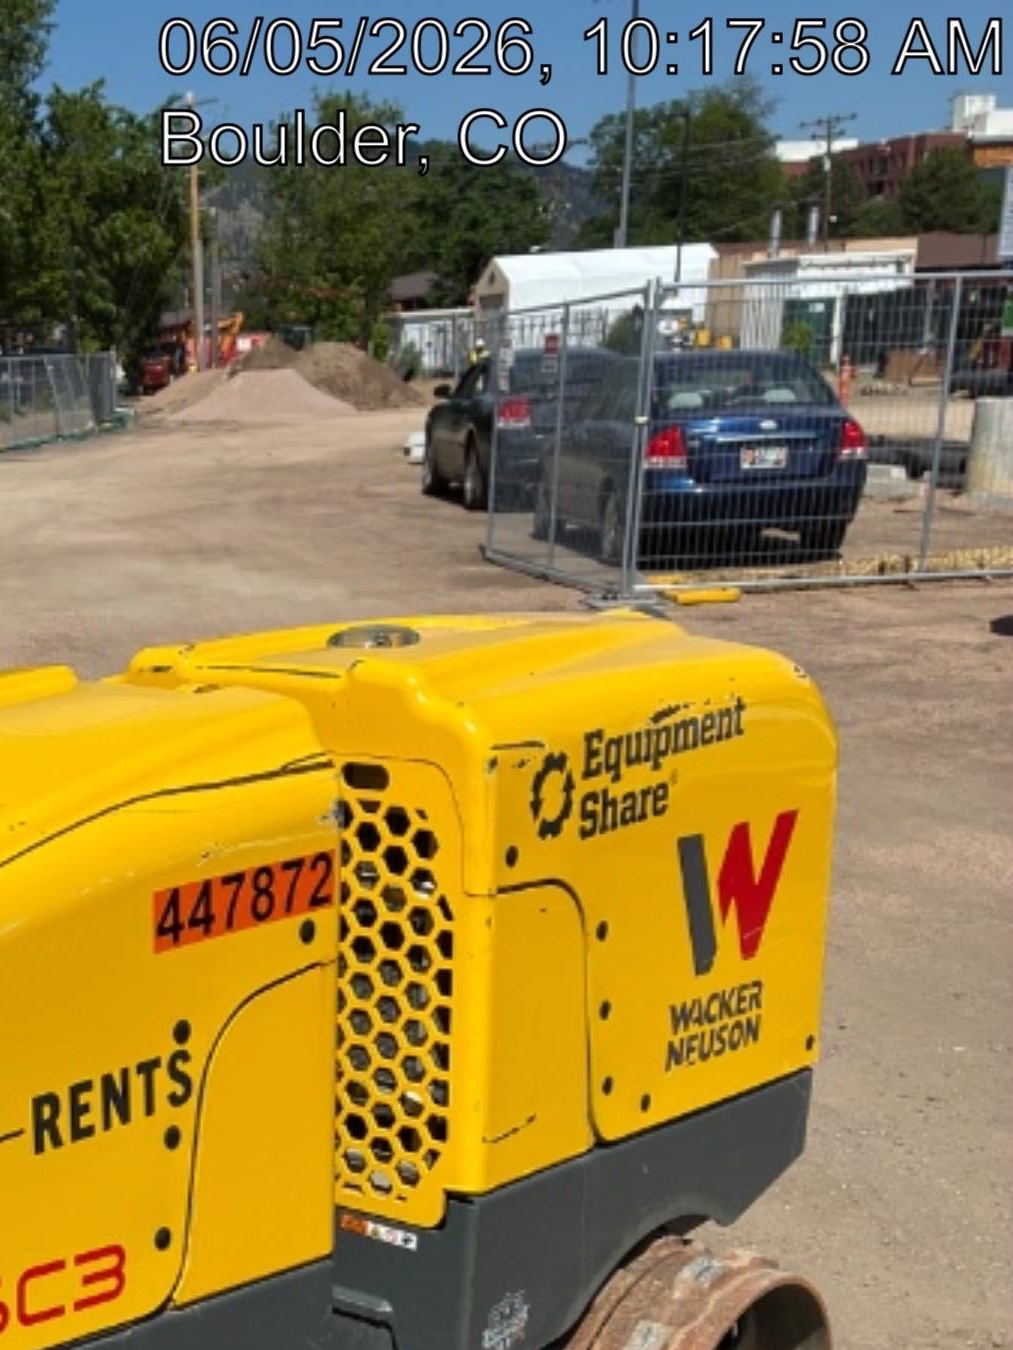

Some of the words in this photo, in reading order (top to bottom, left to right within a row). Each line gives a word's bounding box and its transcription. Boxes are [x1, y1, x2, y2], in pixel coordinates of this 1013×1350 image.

[581, 696, 746, 783] Equipment
[578, 780, 670, 840] Share
[155, 851, 334, 945] 447872
[668, 979, 763, 1036] WACKER
[664, 1013, 762, 1073] NEUSON
